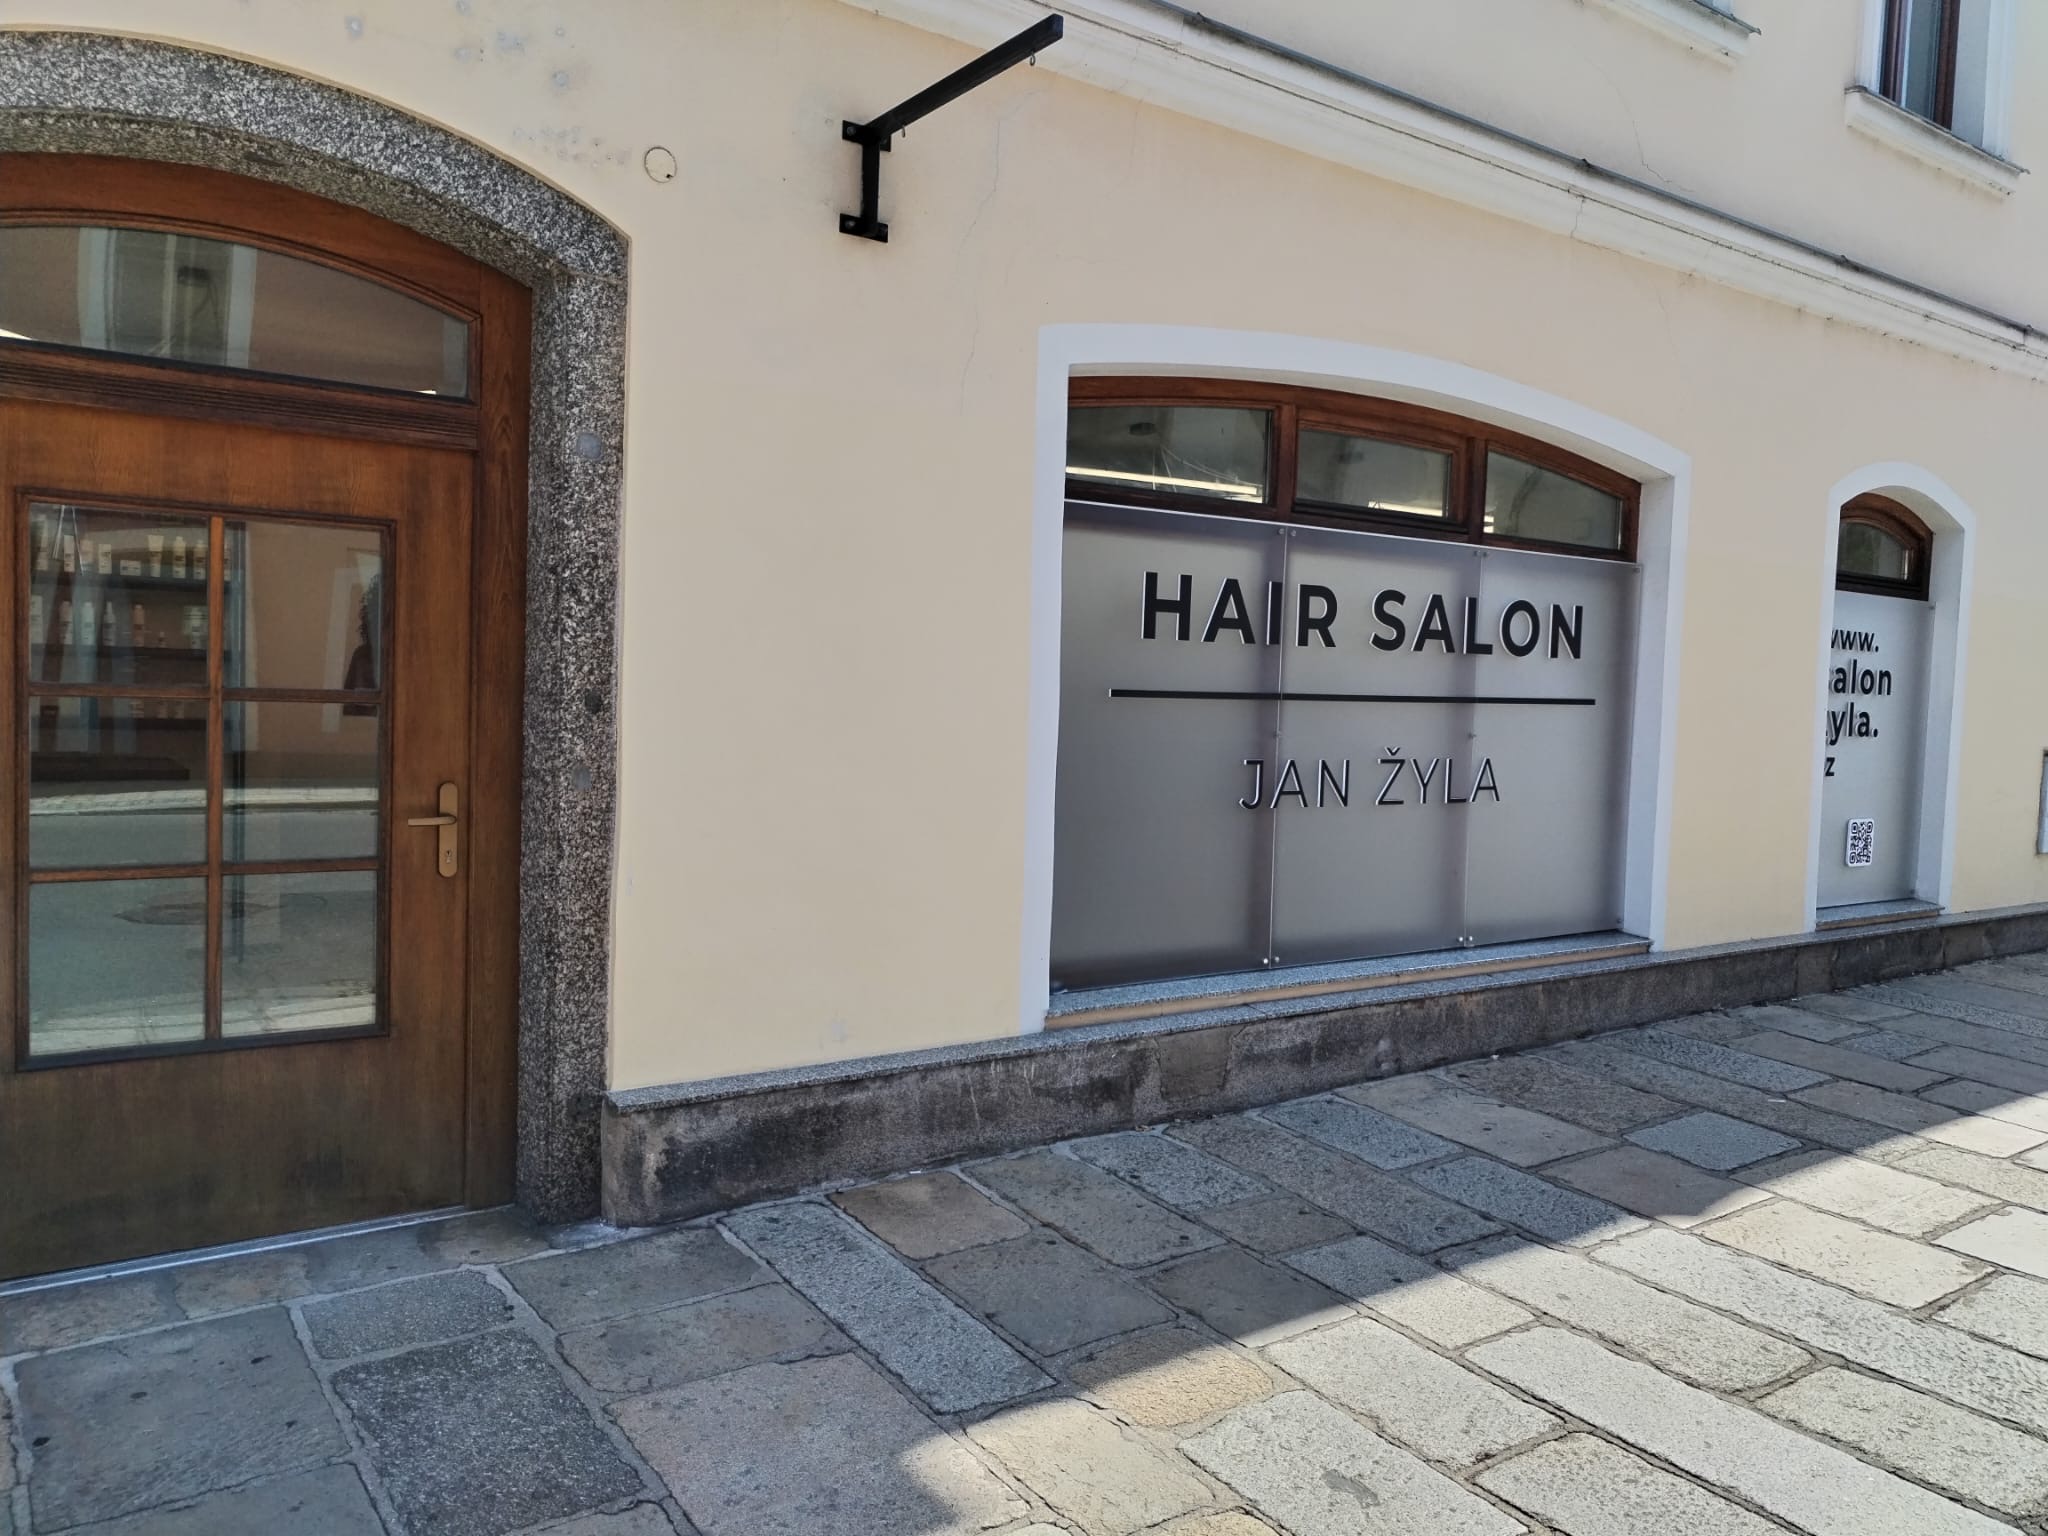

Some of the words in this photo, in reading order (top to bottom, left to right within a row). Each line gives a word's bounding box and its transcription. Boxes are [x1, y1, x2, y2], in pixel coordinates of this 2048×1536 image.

[1141, 570, 1337, 648] HAIR
[1369, 588, 1583, 660] SALON
[1829, 659, 1892, 695] alon
[1825, 702, 1878, 746] yla.
[1239, 758, 1350, 809] JAN
[1375, 746, 1500, 806] ŽYLA
